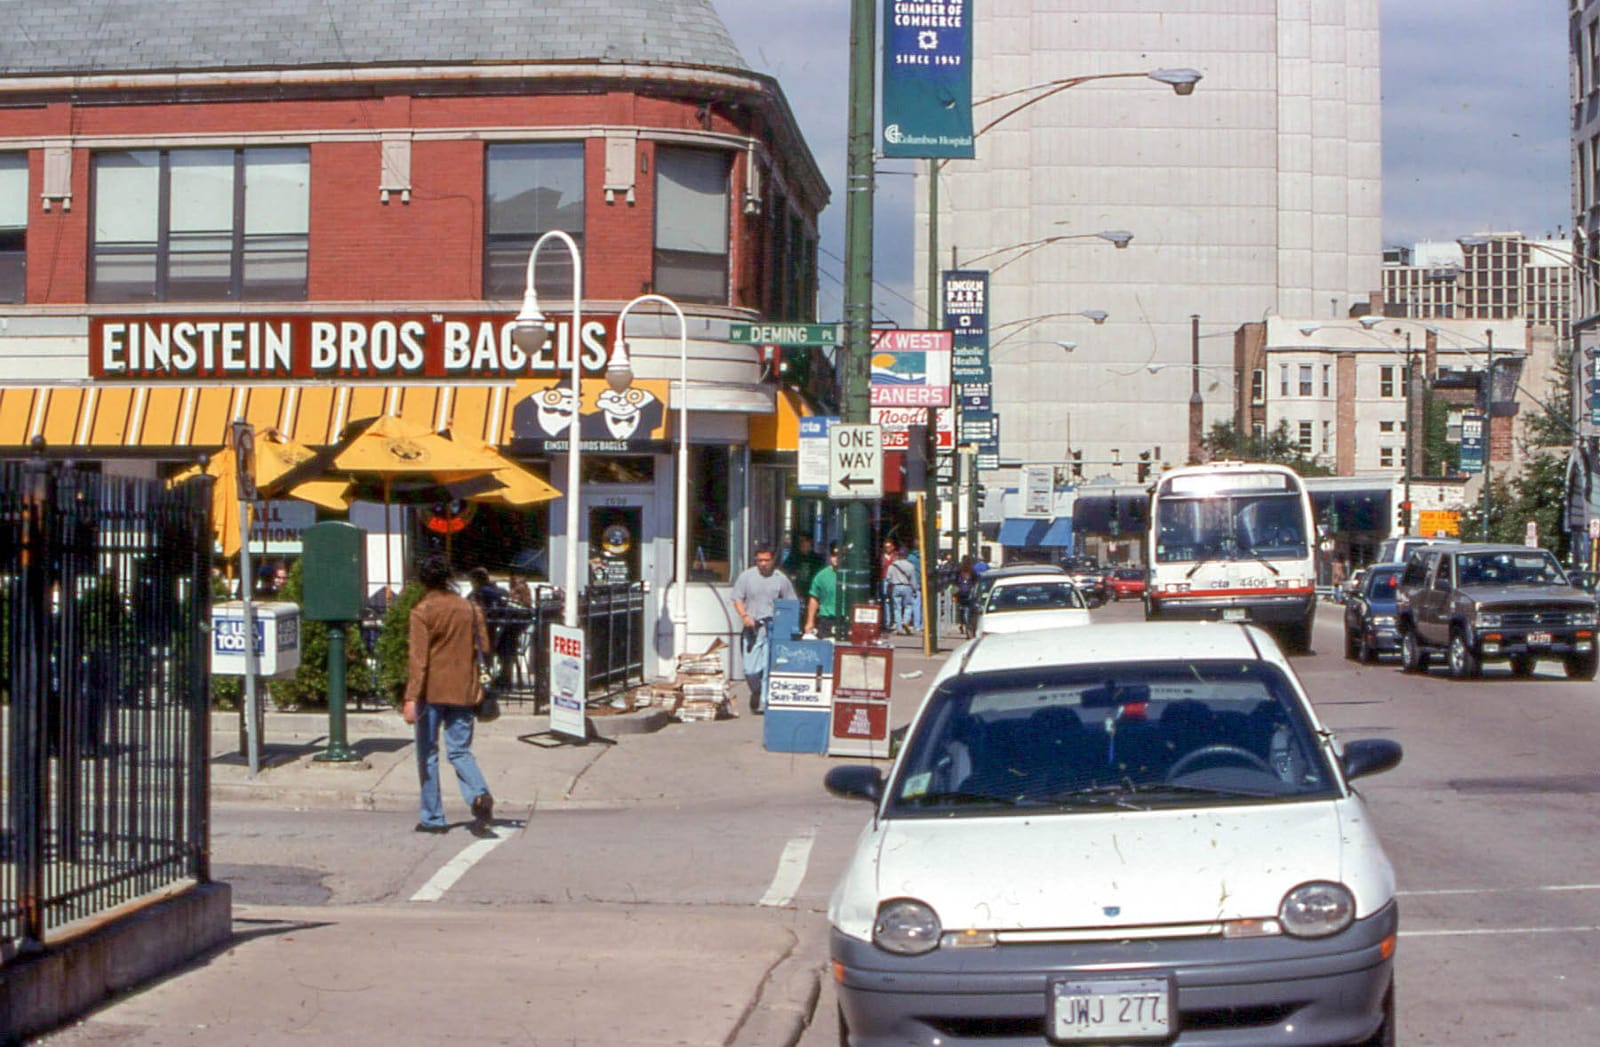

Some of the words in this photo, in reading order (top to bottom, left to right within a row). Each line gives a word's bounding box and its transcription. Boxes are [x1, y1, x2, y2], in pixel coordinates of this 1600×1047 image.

[895, 3, 945, 15] CHAMBER
[947, 4, 962, 15] OF
[895, 14, 962, 28] COMMERCE
[895, 54, 930, 65] SINCE
[939, 135, 972, 148] Hospital
[947, 280, 984, 291] LINCOLN
[947, 291, 984, 301] PARK
[732, 329, 743, 339] W
[750, 326, 809, 343] DEMING
[821, 329, 834, 341] PL
[102, 321, 292, 372] EINSTEIN
[311, 320, 426, 372] BROS
[444, 321, 607, 371] BAGELS
[895, 334, 945, 349] WEST
[838, 430, 875, 448] ONE
[838, 452, 875, 468] WAY
[1210, 578, 1230, 589] cta
[1239, 578, 1268, 588] 4406
[770, 681, 810, 693] Chicago
[770, 691, 820, 703] Sun-Times
[1063, 998, 1105, 1025] JWJ
[1119, 996, 1161, 1023] 277
